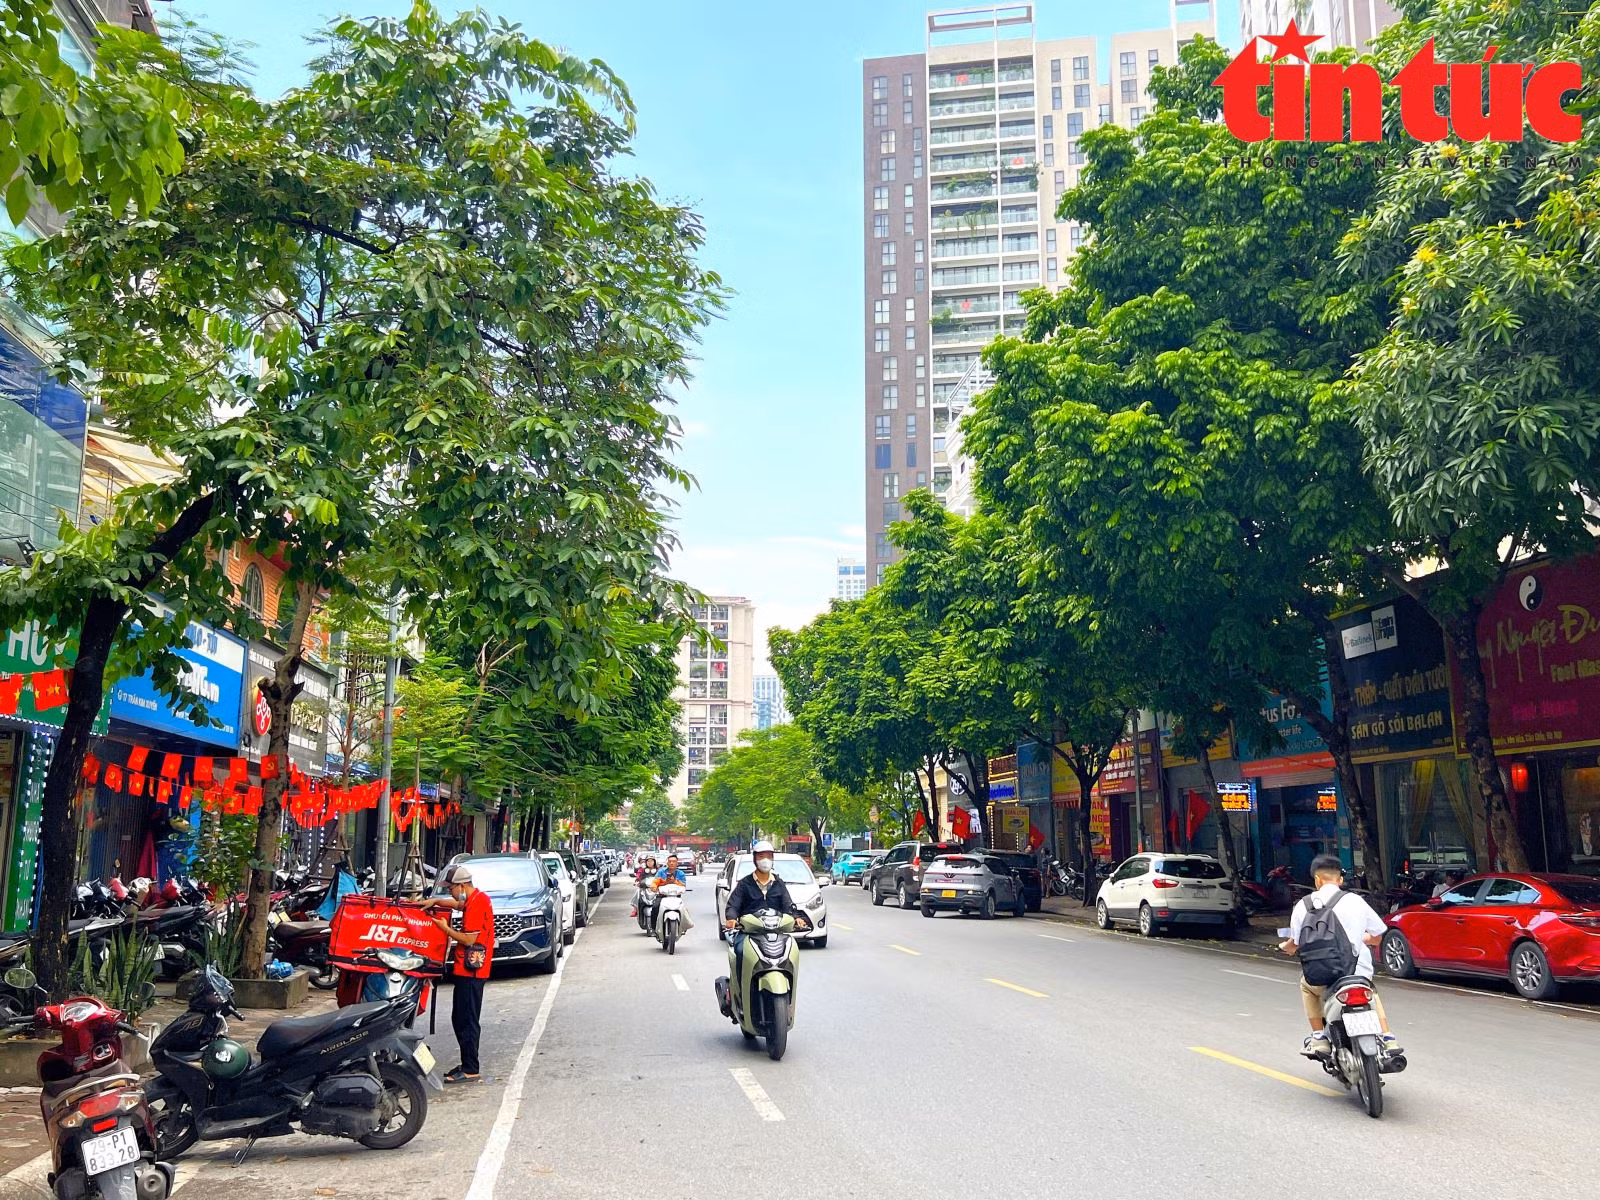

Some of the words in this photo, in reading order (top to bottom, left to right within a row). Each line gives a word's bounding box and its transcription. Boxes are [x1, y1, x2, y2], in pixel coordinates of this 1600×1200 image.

[360, 923, 407, 943] J&T
[397, 936, 429, 948] EXPRESS
[90, 1132, 127, 1156] 29-P1
